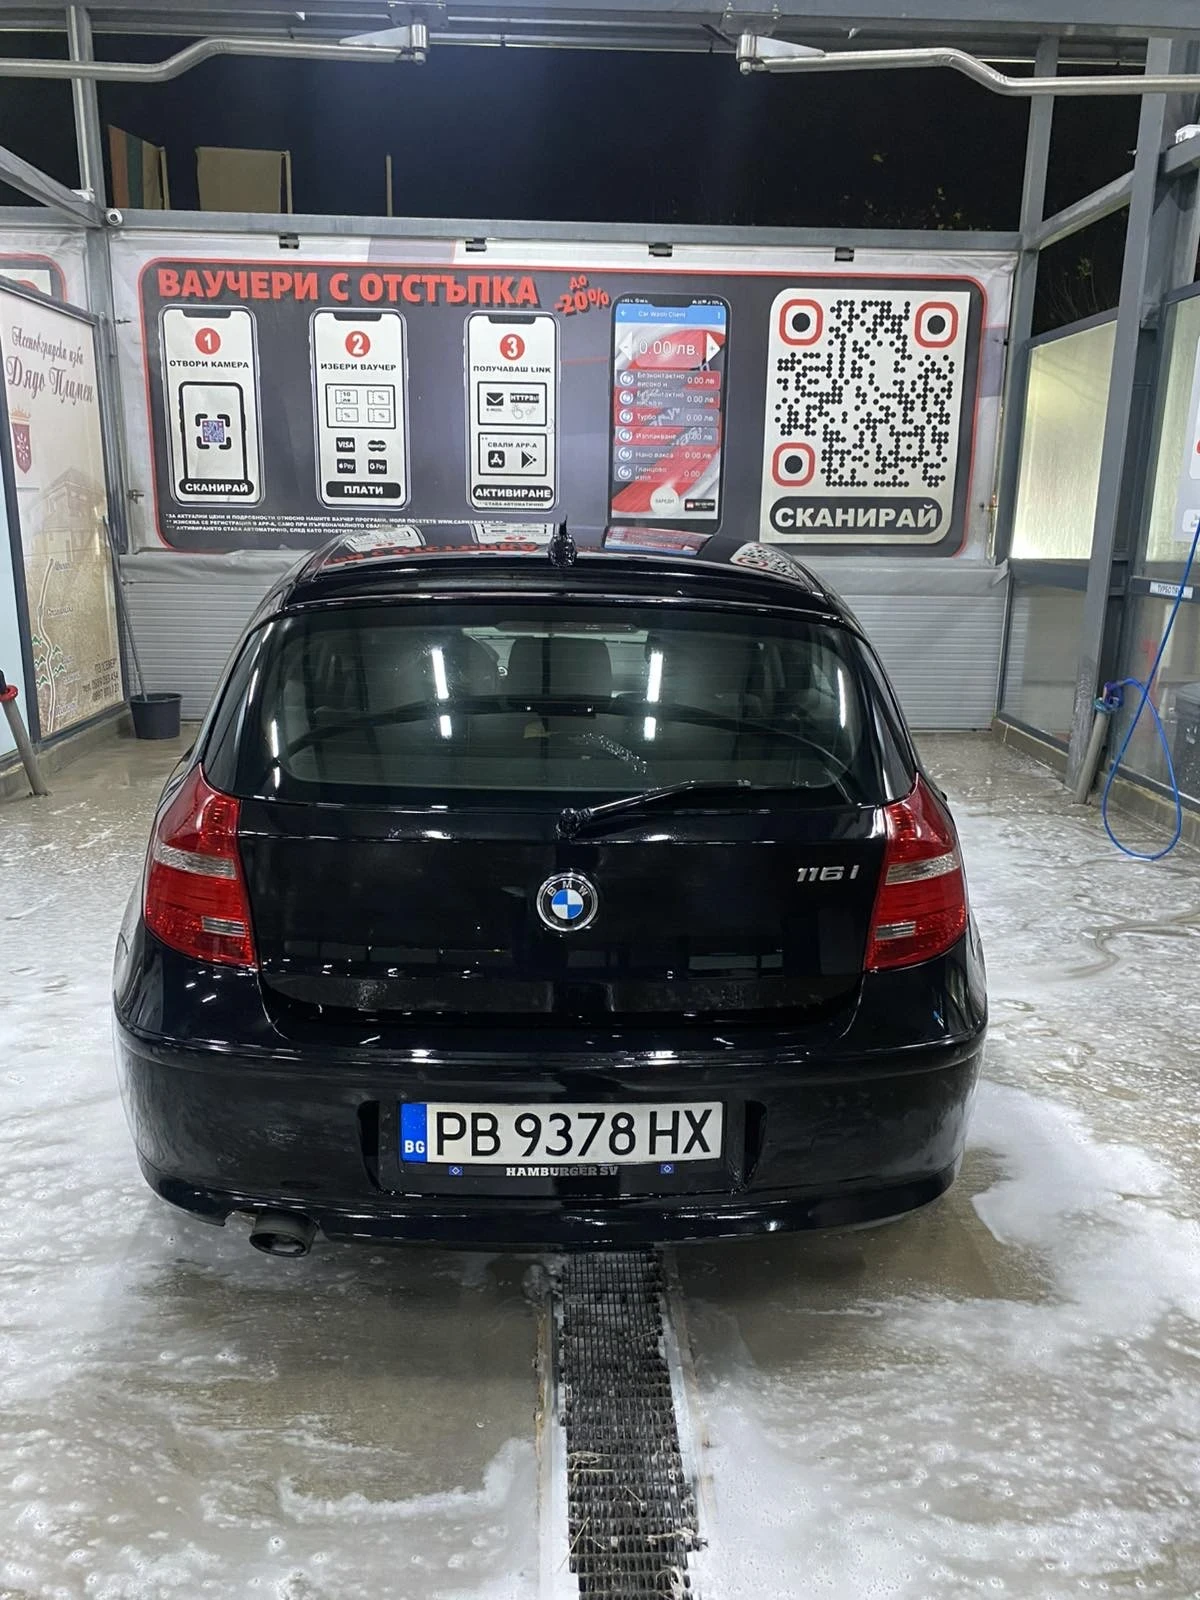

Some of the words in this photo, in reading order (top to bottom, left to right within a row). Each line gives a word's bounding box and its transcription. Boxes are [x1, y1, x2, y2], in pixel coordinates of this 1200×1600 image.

[157, 268, 319, 300] ВАУЧЕРИ
[328, 272, 349, 302] С
[359, 272, 539, 305] ОТСТЪПКА
[569, 275, 588, 290] ДО
[554, 287, 610, 315] -20%
[203, 333, 212, 350] 1
[351, 334, 364, 355] 2
[507, 337, 518, 358] 3
[640, 340, 673, 355] 0.00
[676, 345, 699, 356] лв.
[169, 360, 208, 368] ОТВОРИ
[210, 361, 249, 369] КАМЕРА
[320, 363, 358, 371] ИЗБЕРИ
[360, 363, 397, 371] ВАУЧЕР
[473, 365, 528, 373] ПОЛУЧАВАШ
[6, 355, 45, 399] Дядо
[49, 366, 94, 405] Пламен
[185, 483, 249, 493] СКАНИРАЙ
[343, 485, 384, 495] ПЛАТИ
[475, 488, 552, 498] АКТИВИРАНЕ
[774, 504, 938, 528] СКАНИРАЙ
[546, 880, 589, 898] BMW
[436, 1111, 501, 1157] PB
[514, 1111, 636, 1157] 9378
[649, 1109, 713, 1156] HX
[404, 1140, 425, 1154] BG
[506, 1167, 598, 1177] HAMBURGER
[599, 1166, 619, 1177] SV
